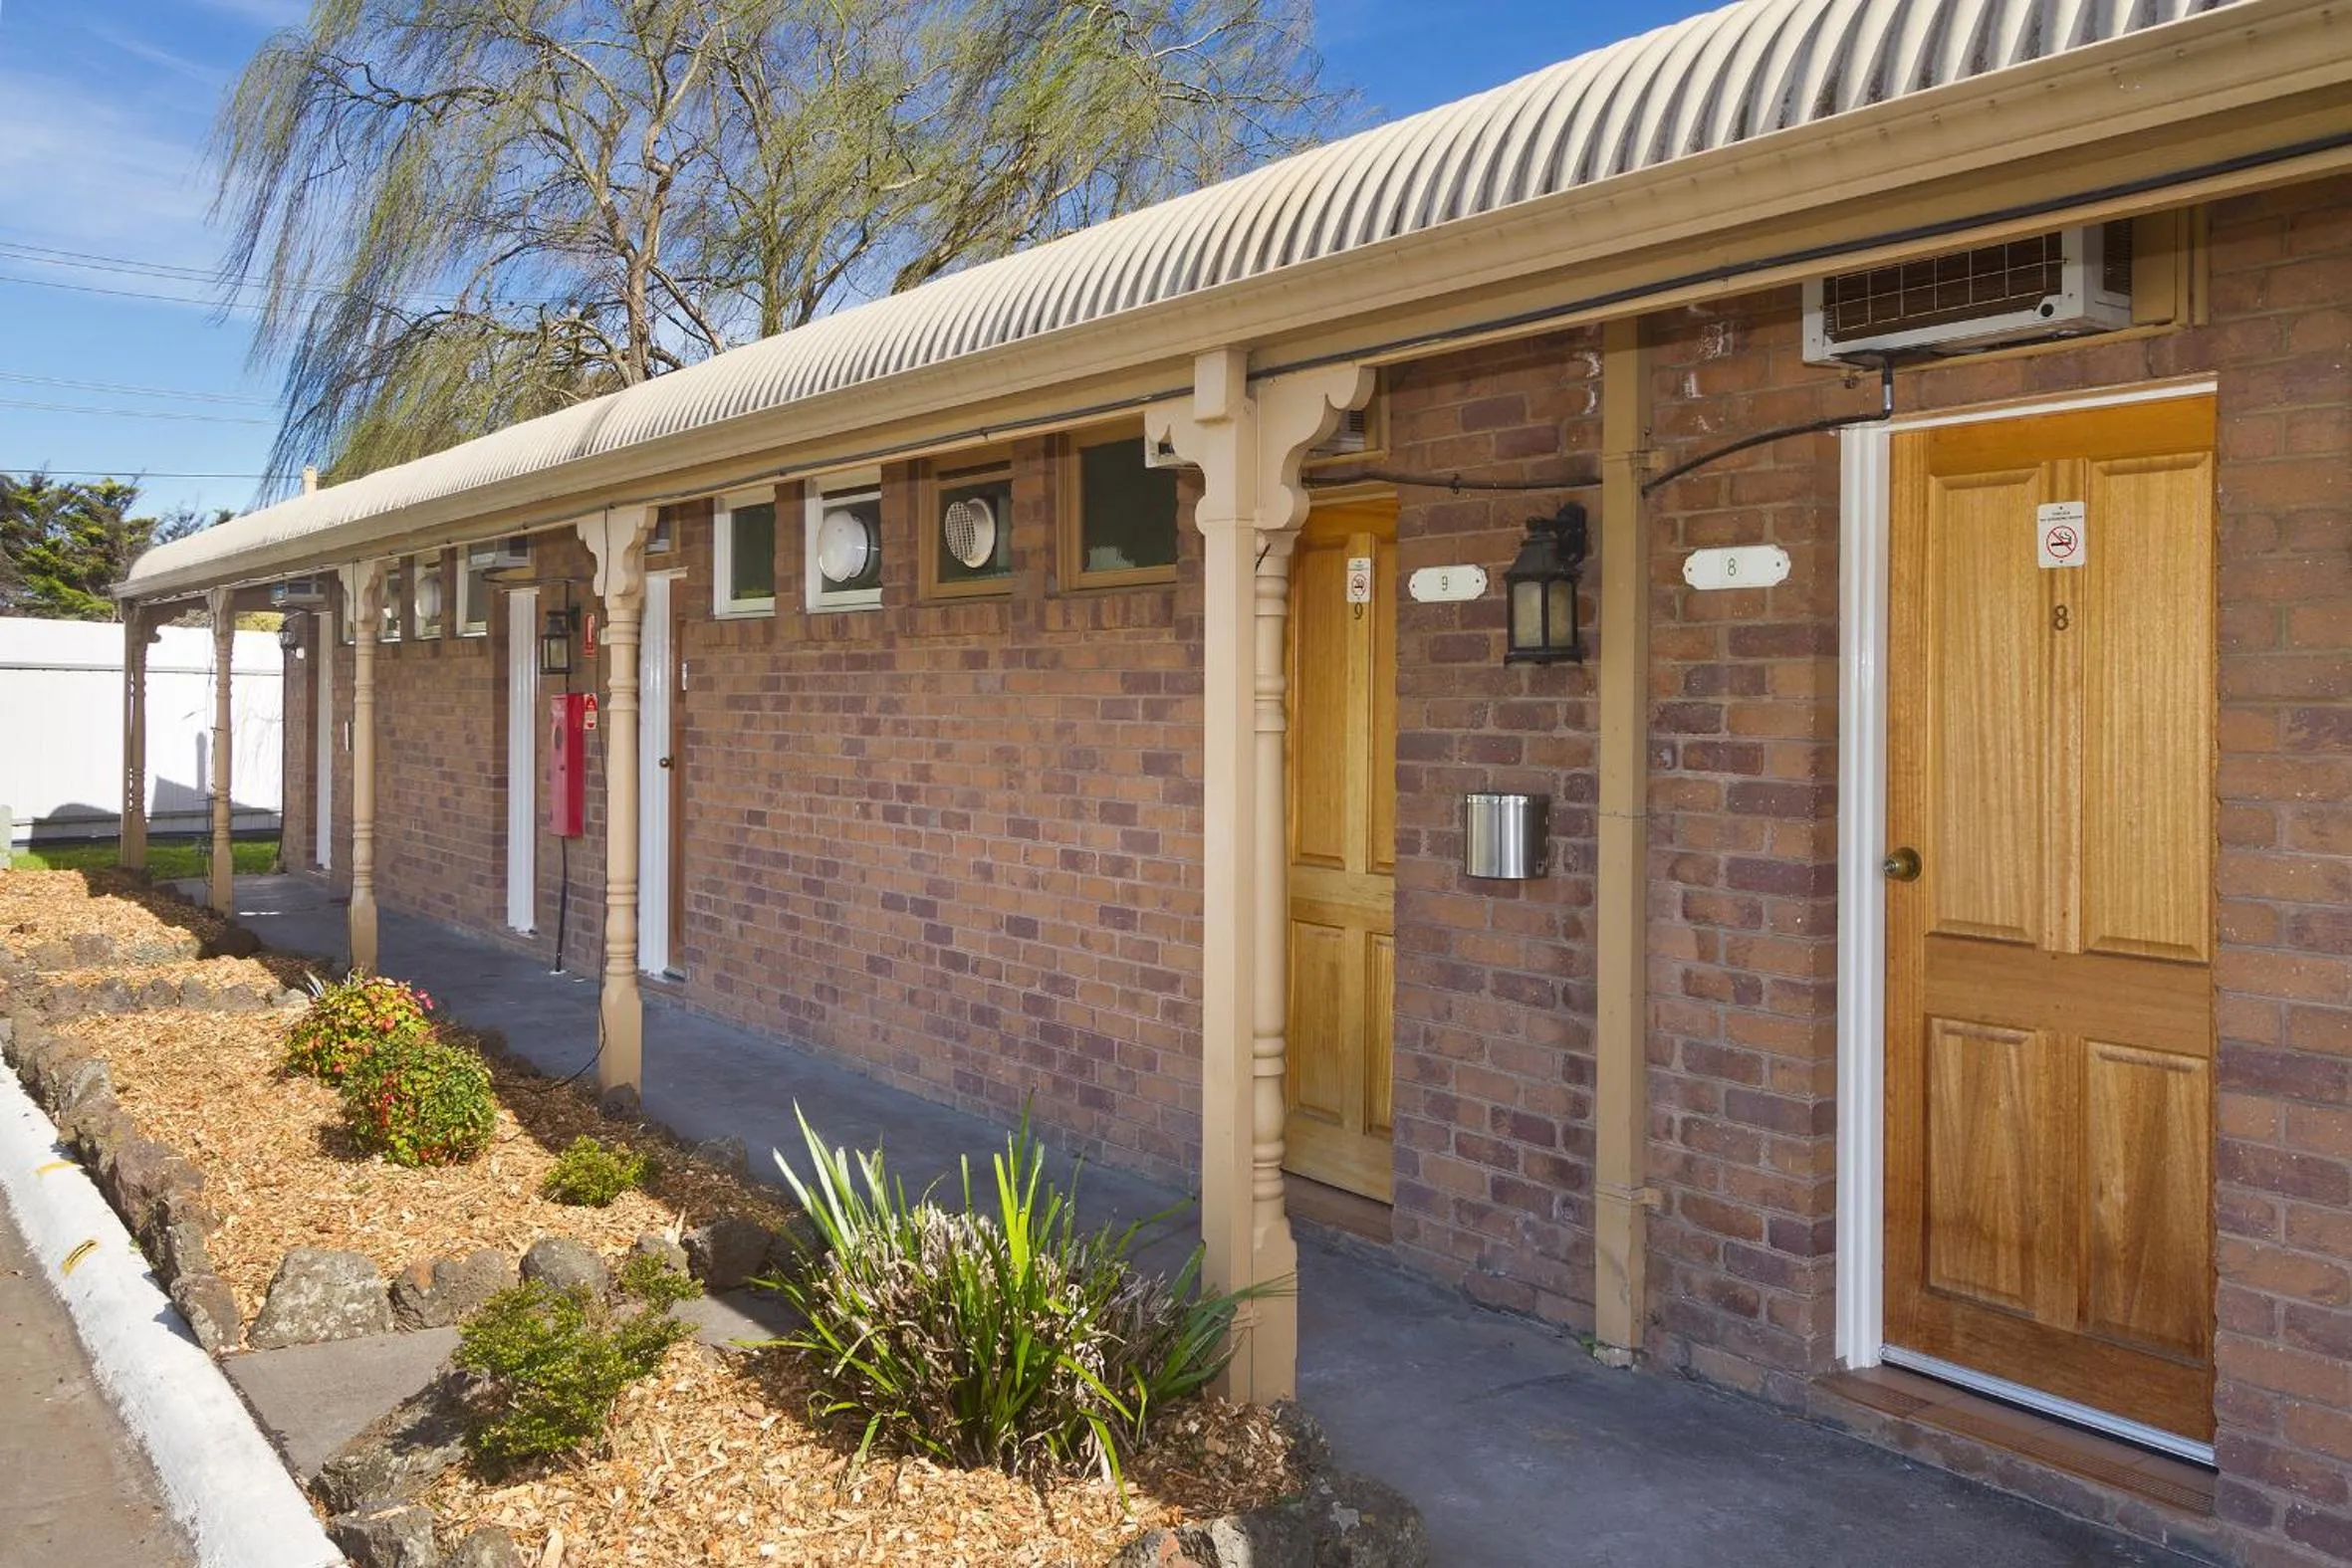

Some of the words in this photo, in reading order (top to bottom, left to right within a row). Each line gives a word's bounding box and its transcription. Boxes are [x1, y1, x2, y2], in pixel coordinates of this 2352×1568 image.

[1727, 557, 1737, 576] 8
[1441, 574, 1449, 592] 9
[1353, 601, 1364, 620] 9
[2053, 603, 2069, 631] 8
